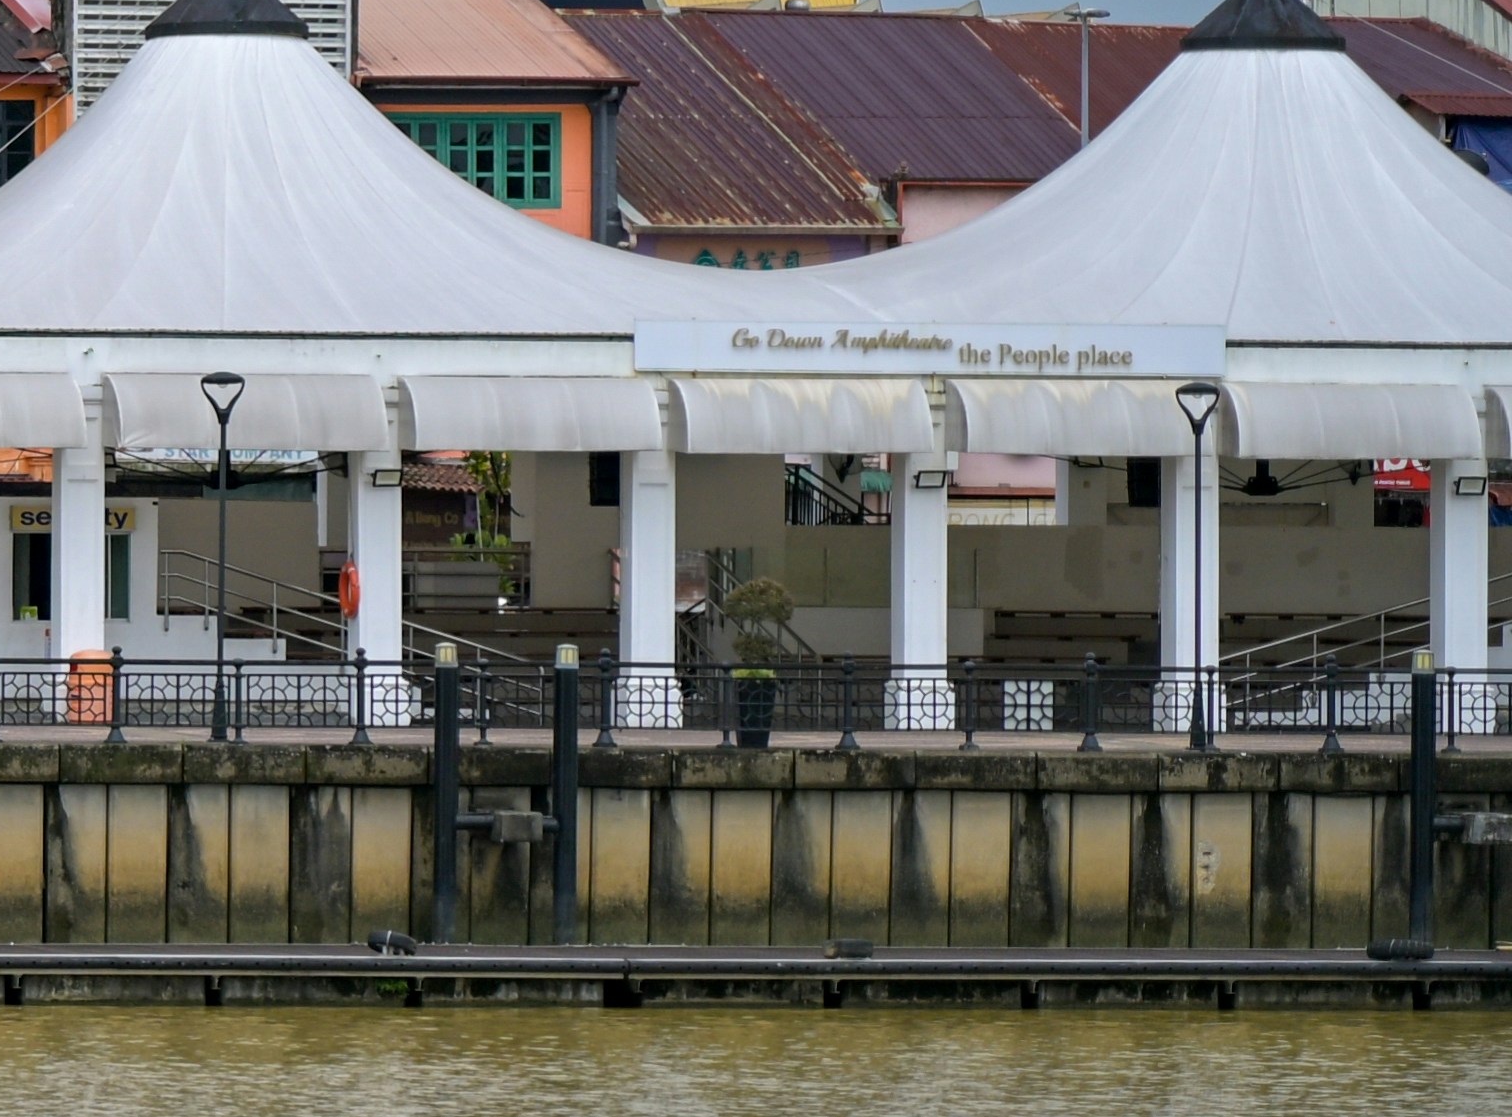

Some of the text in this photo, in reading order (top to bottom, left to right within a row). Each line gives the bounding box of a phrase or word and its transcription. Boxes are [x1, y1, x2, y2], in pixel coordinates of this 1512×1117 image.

[732, 328, 953, 354] Go Down Amphitheatre
[959, 343, 1133, 372] the People place
[20, 508, 129, 530] sety
